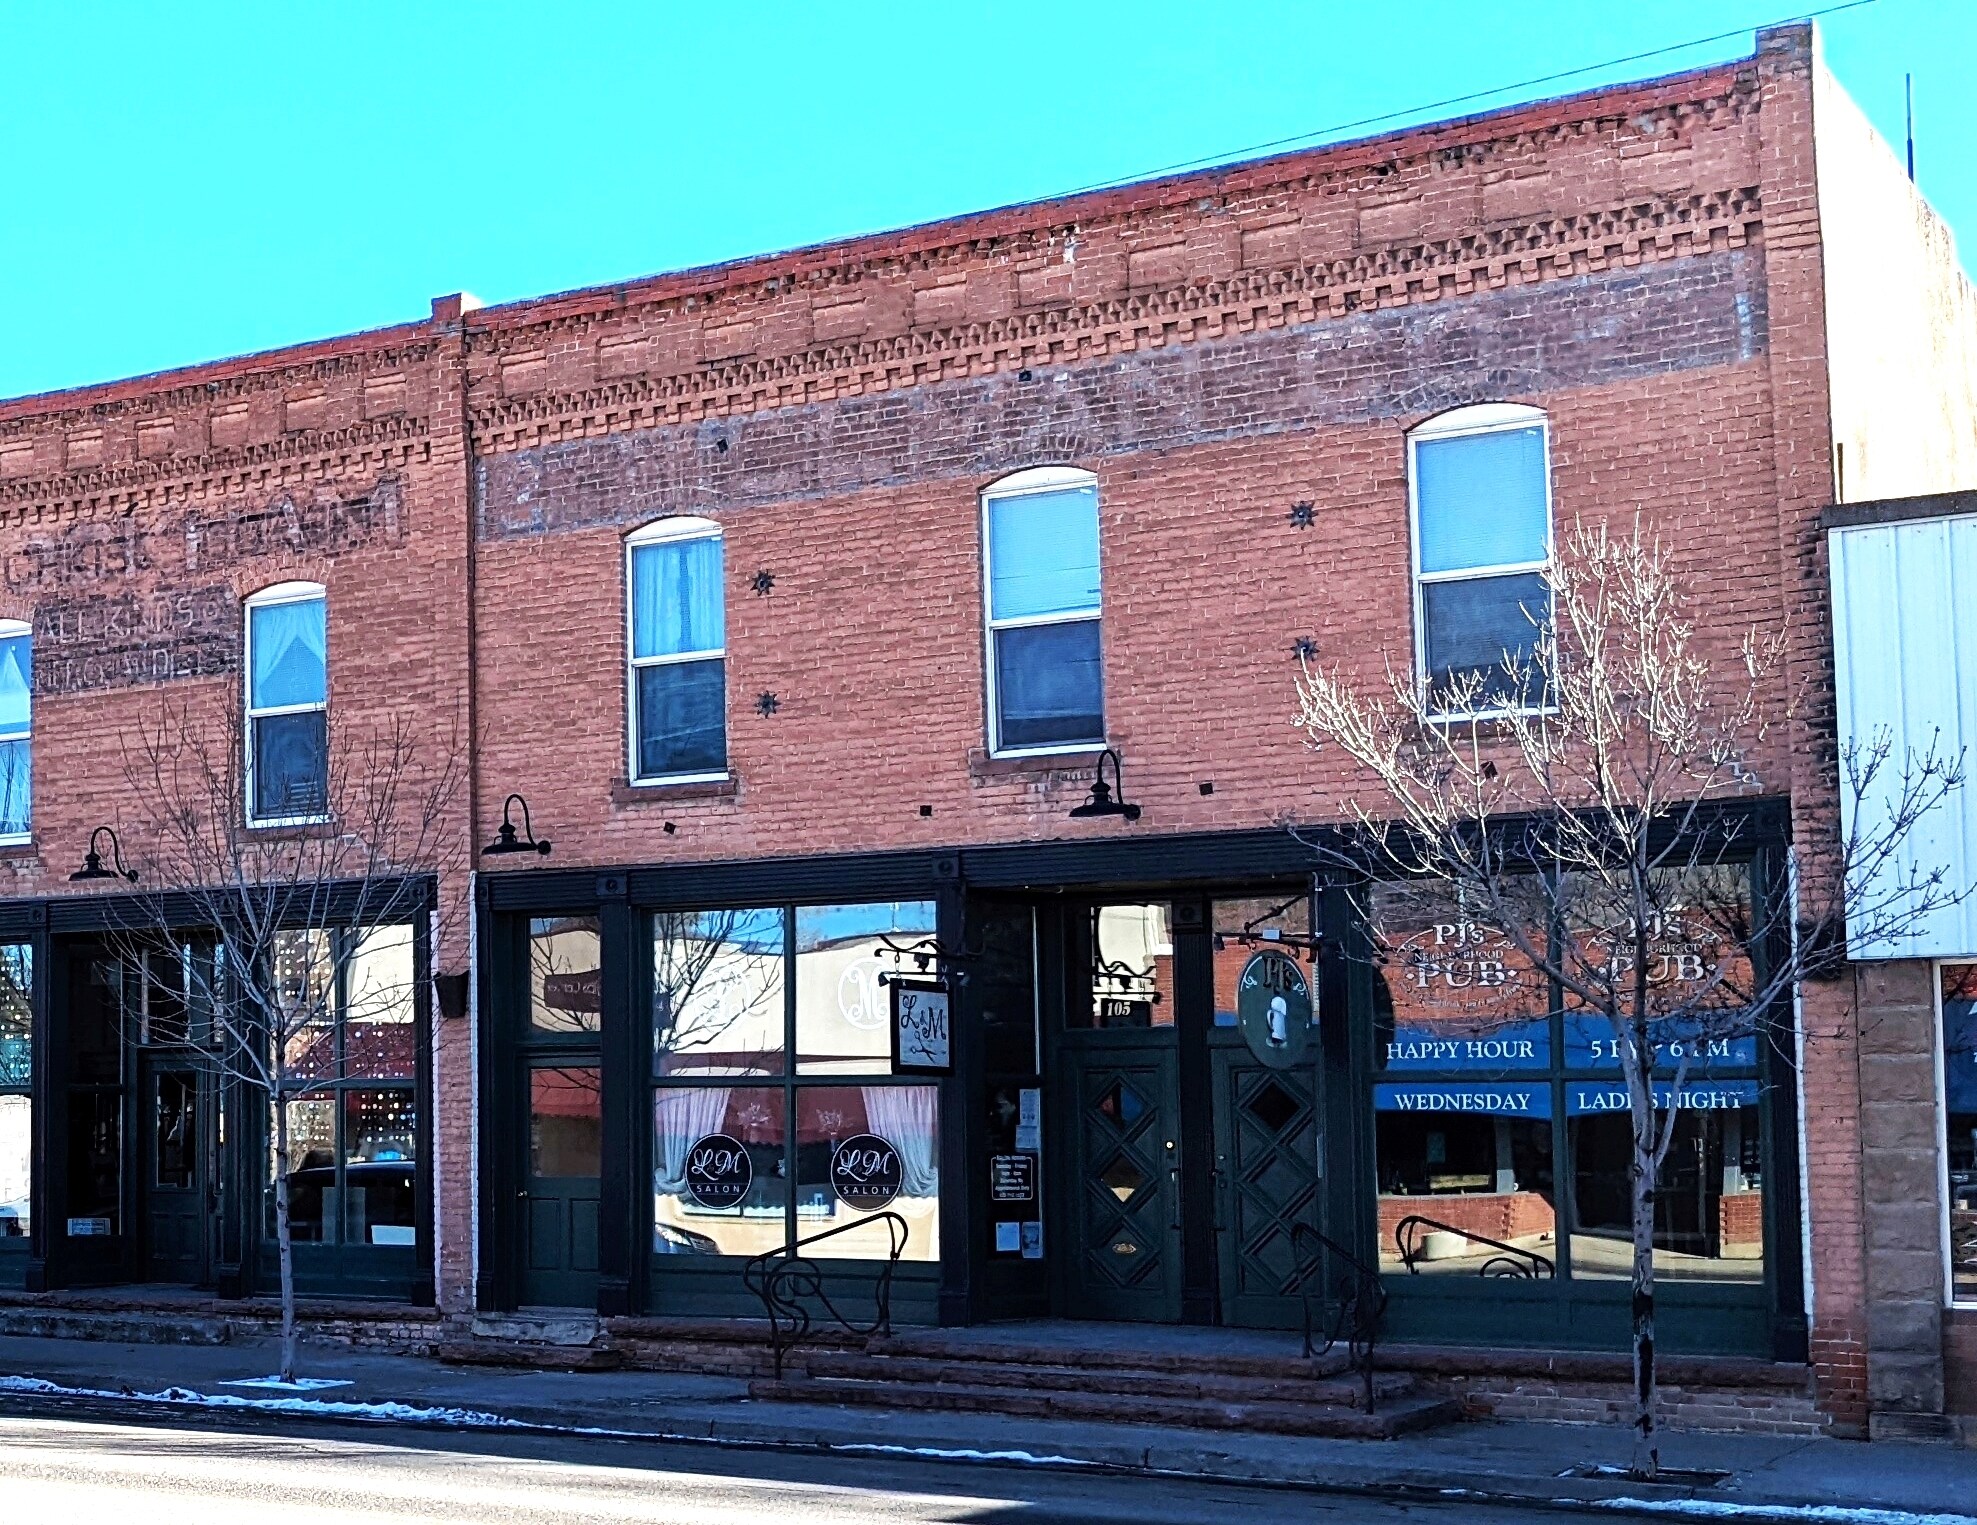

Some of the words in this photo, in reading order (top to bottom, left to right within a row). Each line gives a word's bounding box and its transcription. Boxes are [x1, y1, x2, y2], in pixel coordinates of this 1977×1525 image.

[1433, 920, 1485, 948] PJ's
[1414, 949, 1504, 964] NEIGHBRHOOD
[1416, 961, 1506, 988] PUB
[1610, 954, 1704, 982] PUB
[1107, 1001, 1131, 1017] 105
[1386, 1041, 1460, 1060] HAPPY
[1466, 1040, 1535, 1059] HOUR
[1590, 1040, 1602, 1059] 5
[1670, 1040, 1684, 1058] 6
[1691, 1038, 1730, 1058] M
[1394, 1093, 1531, 1111] WEDNESDAY
[1578, 1091, 1658, 1110] LADIS
[1664, 1090, 1743, 1110] NIGHT
[696, 1184, 740, 1193] SALON
[843, 1185, 890, 1195] SALON
